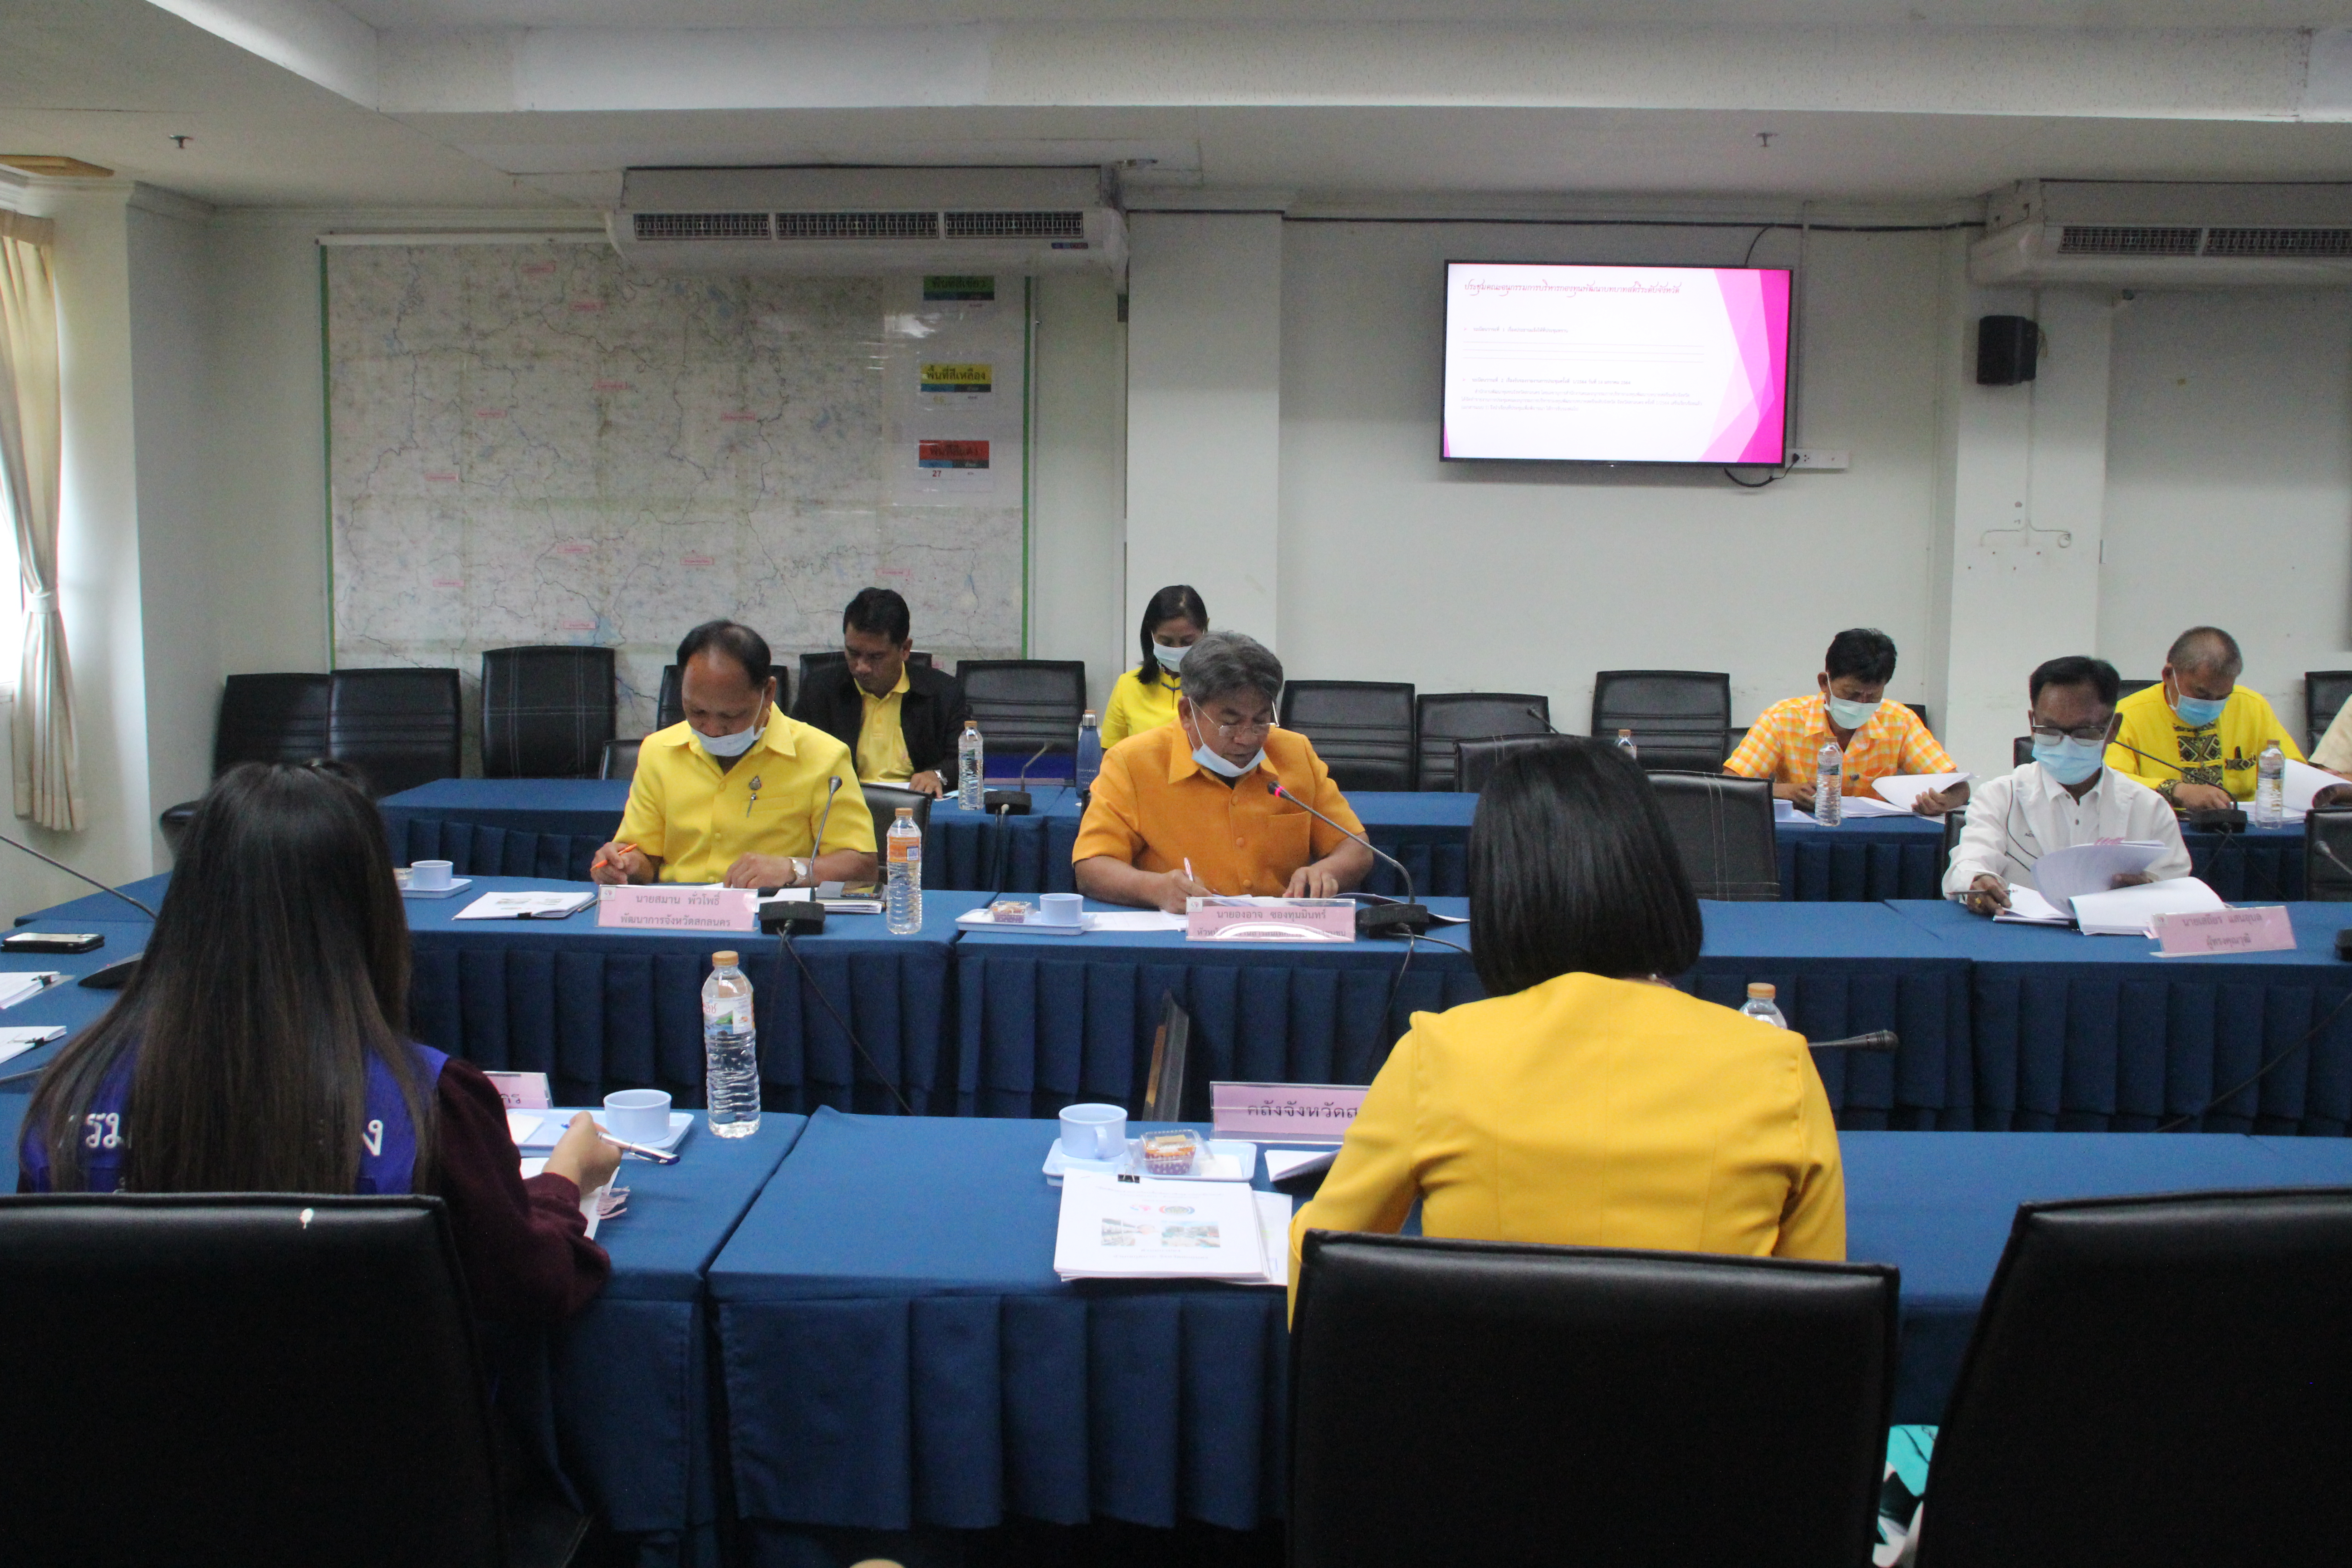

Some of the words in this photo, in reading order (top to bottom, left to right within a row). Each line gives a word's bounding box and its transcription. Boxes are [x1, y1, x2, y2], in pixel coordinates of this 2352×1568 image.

[1464, 279, 1682, 297] ประชุมคณะอนุกรรมการบริหารกองทุนพัฒนาบทบาทสตรีระดับจังหวัด
[927, 365, 985, 382] พื้นที่สีเหลือง
[636, 894, 681, 905] นายสมาน
[620, 912, 731, 927] พัฒนาการจังหวัดสกลนคร
[1216, 910, 1263, 919] นายองอาจ
